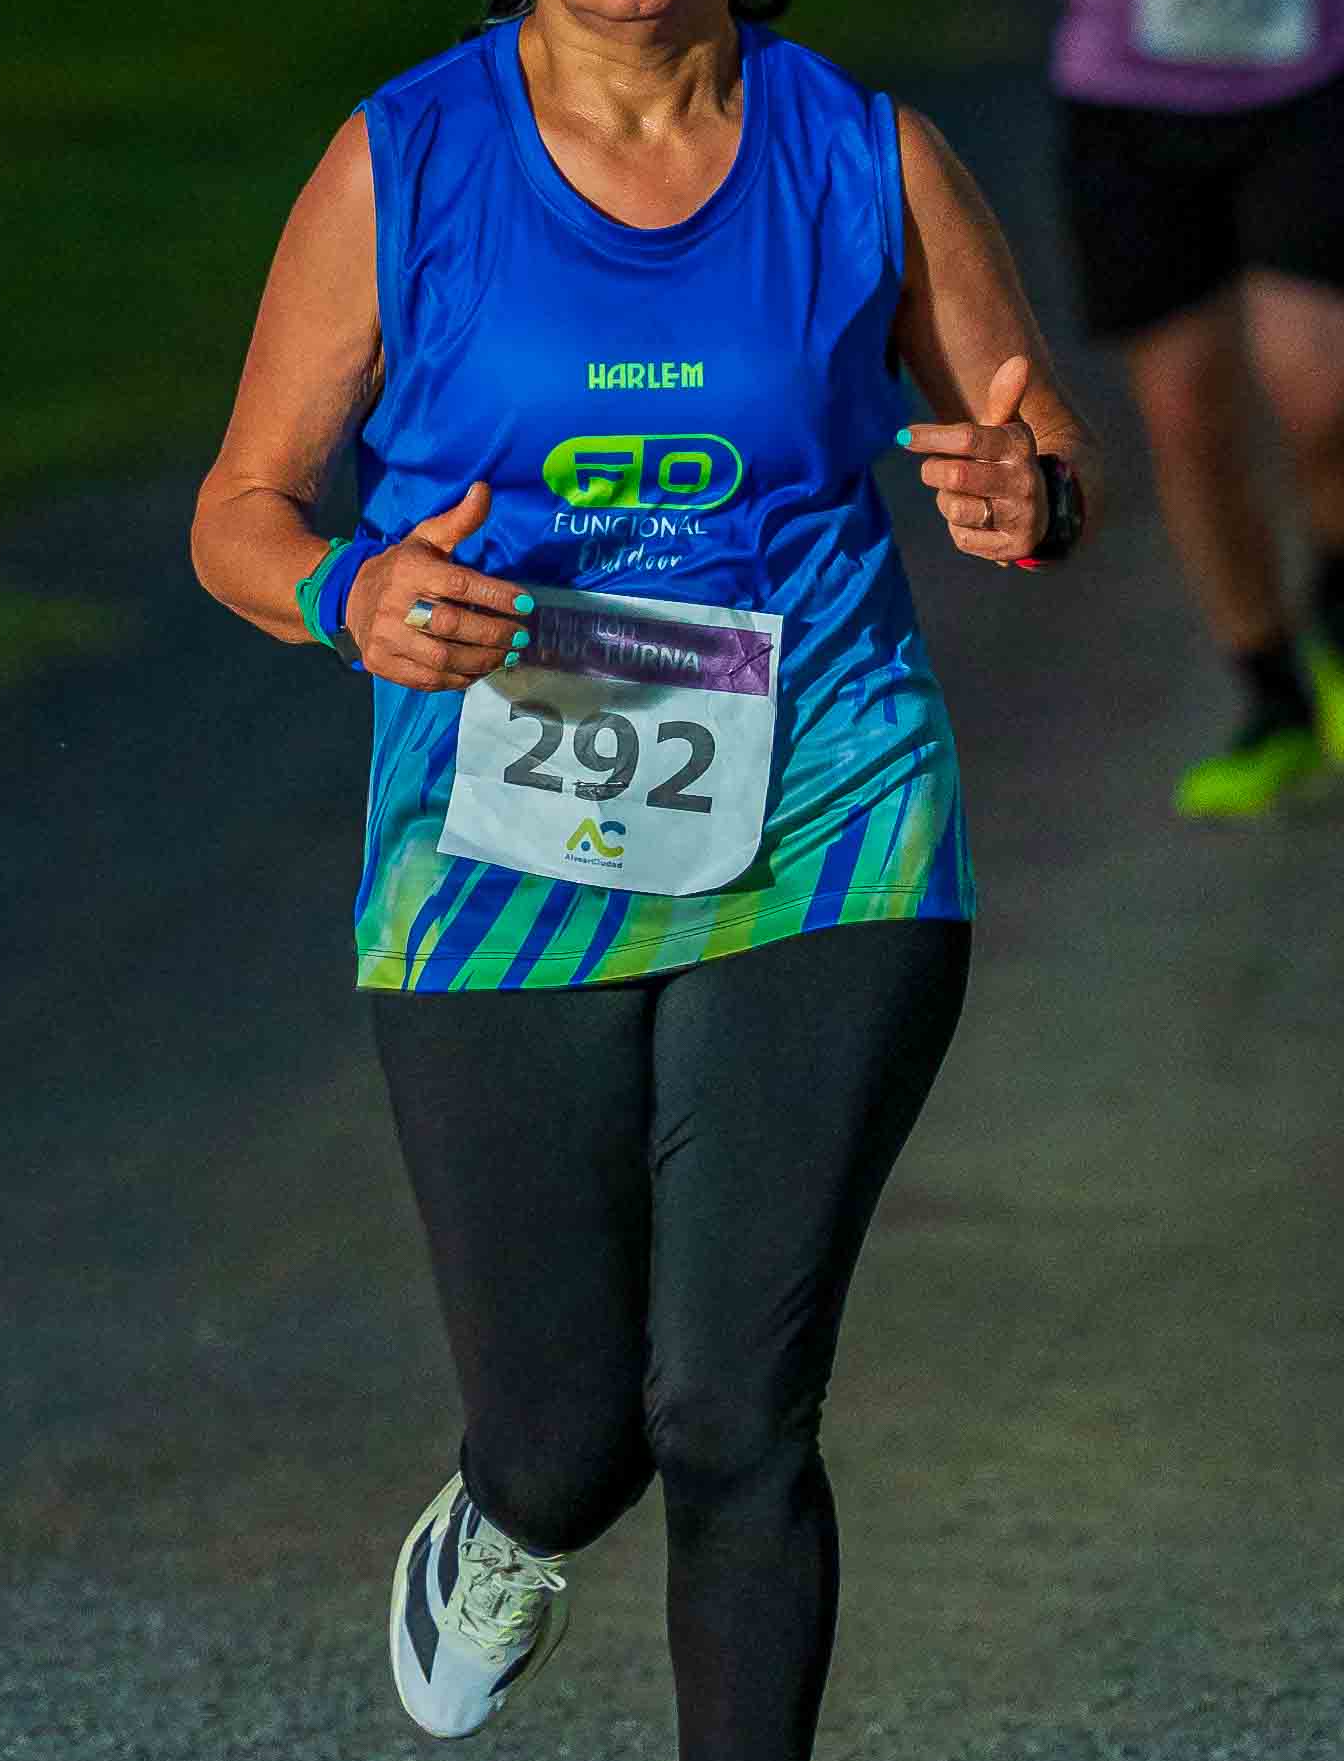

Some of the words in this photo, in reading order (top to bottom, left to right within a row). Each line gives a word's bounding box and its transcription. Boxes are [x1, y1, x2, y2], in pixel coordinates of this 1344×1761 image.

[587, 361, 705, 390] HARLEM
[554, 511, 709, 538] FUNCIONAL
[504, 702, 716, 815] 292
